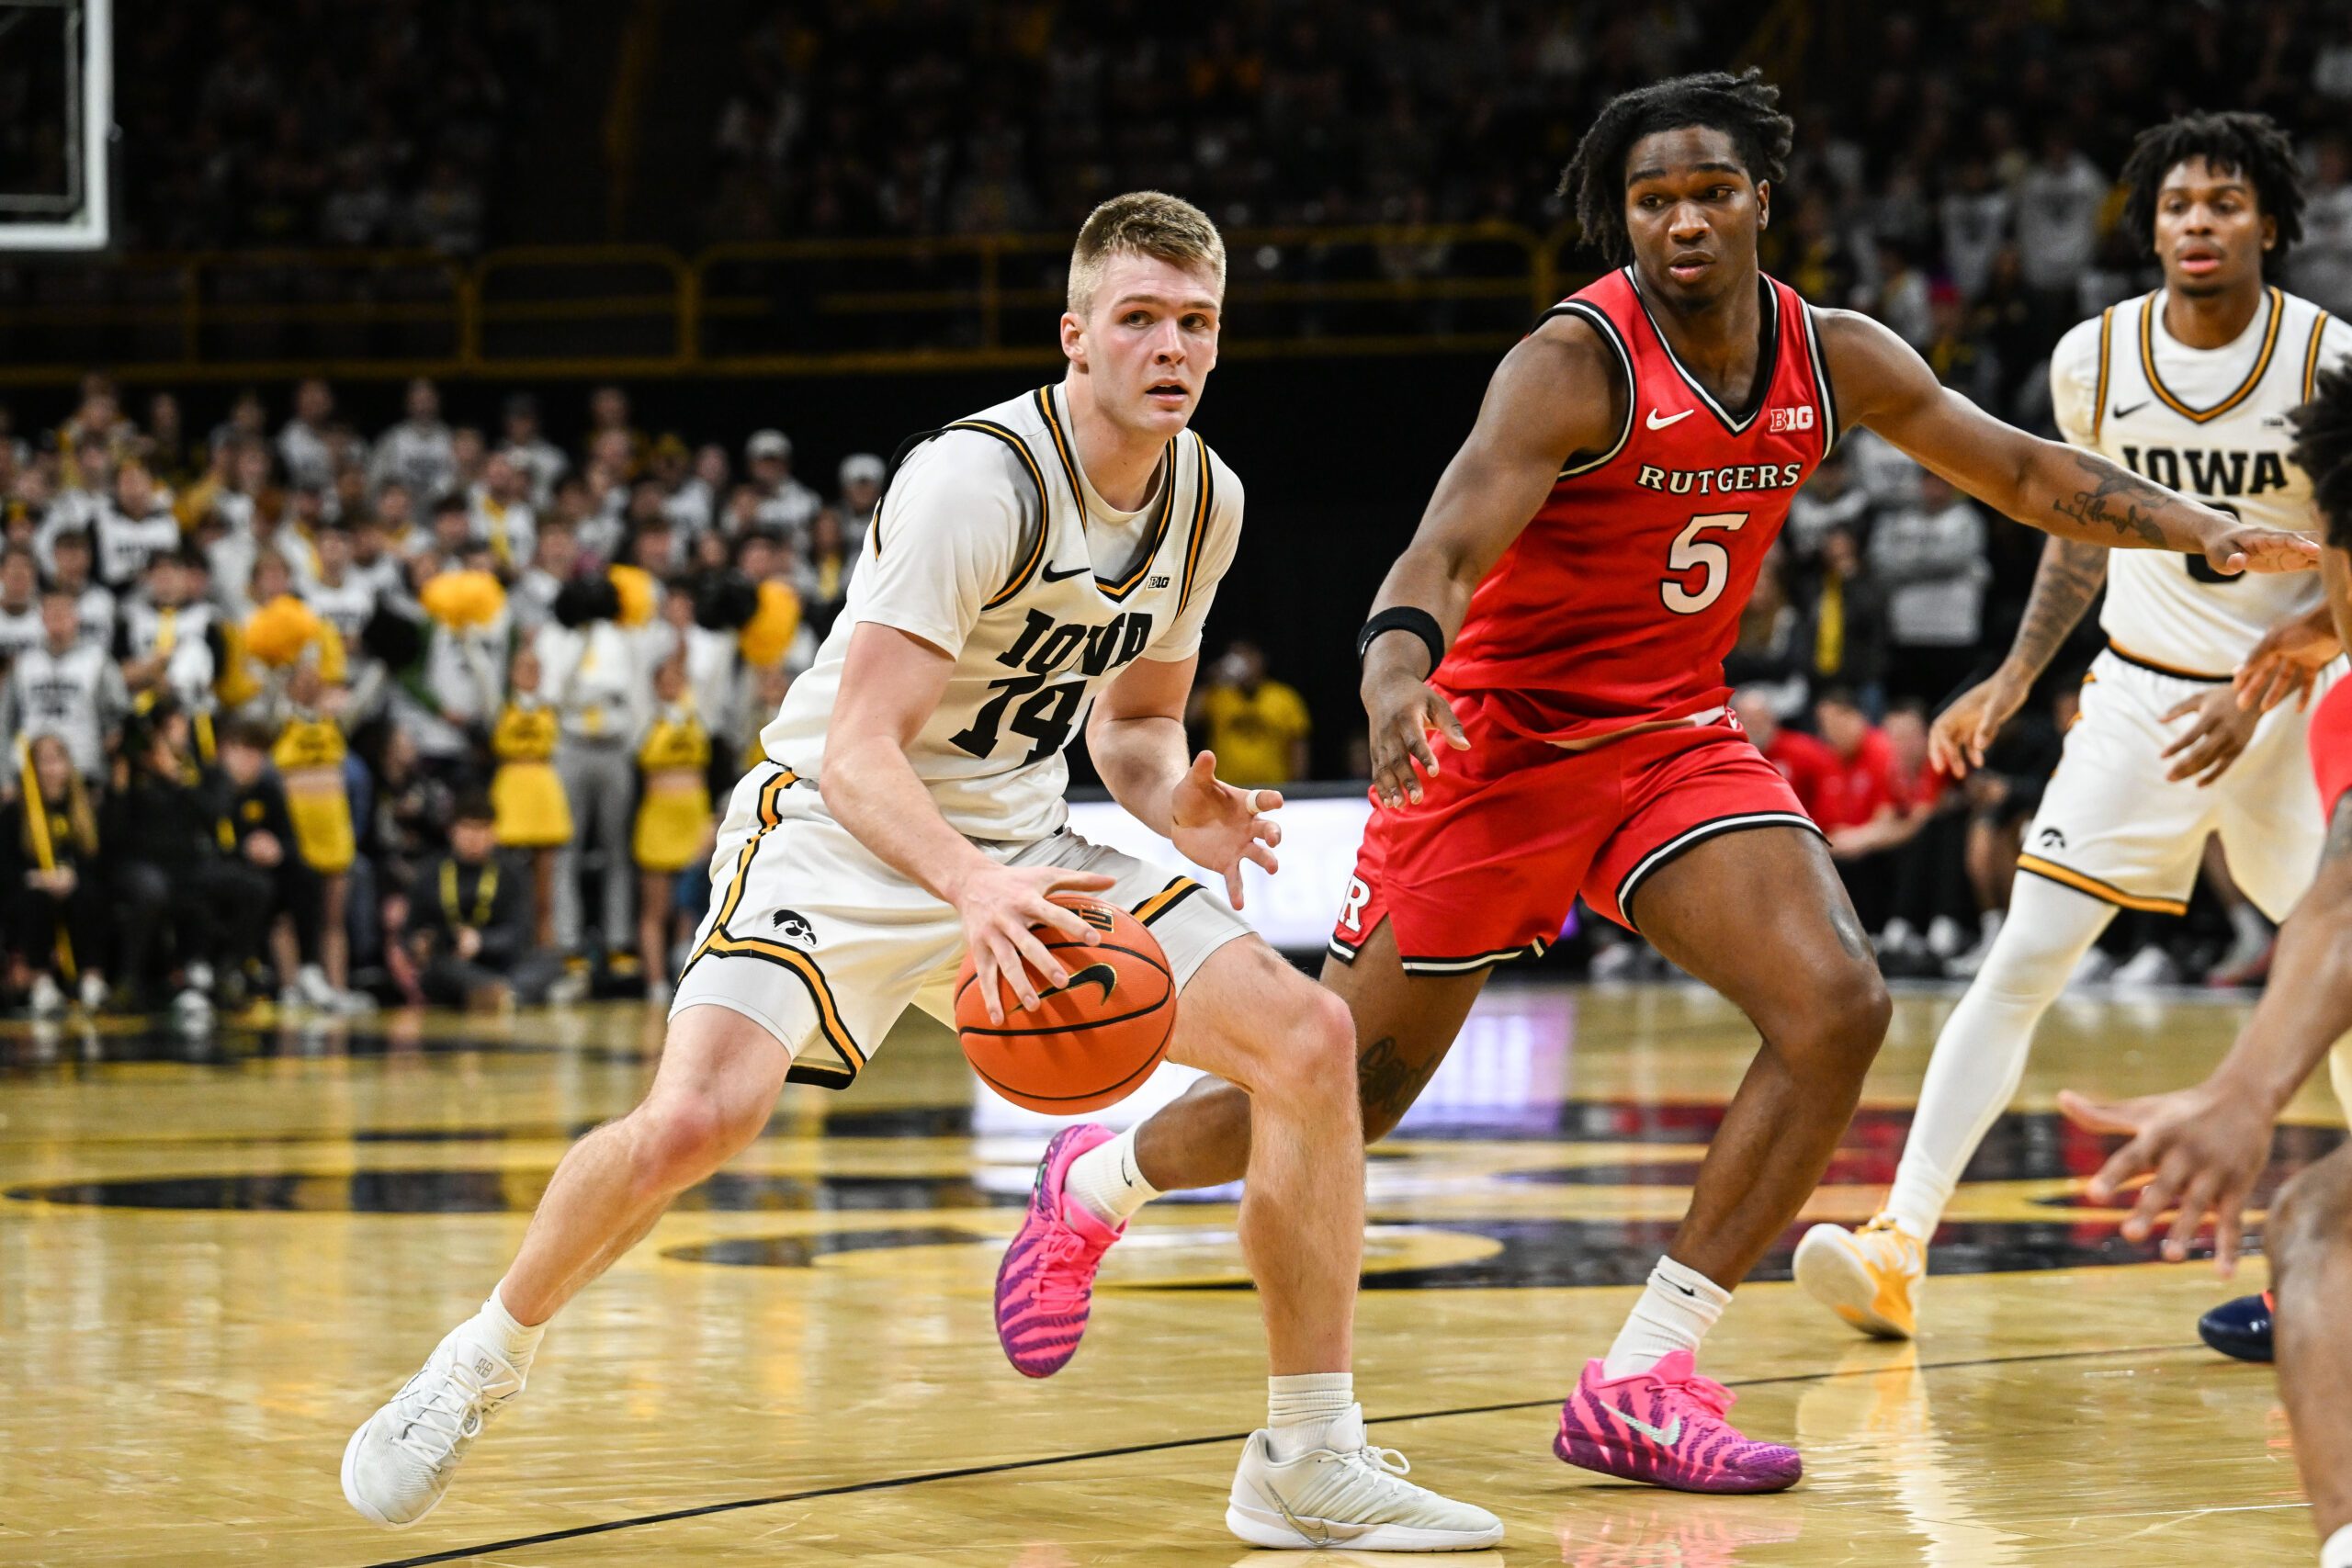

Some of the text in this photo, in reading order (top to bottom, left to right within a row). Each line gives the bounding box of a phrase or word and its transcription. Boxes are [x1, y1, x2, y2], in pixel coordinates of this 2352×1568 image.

[1635, 462, 1804, 495] RUTGERS
[2122, 446, 2289, 496] IOWA
[1660, 512, 1750, 615] 5
[995, 607, 1153, 677] IOWA
[947, 673, 1088, 768] 14
[1338, 874, 1371, 933] R
